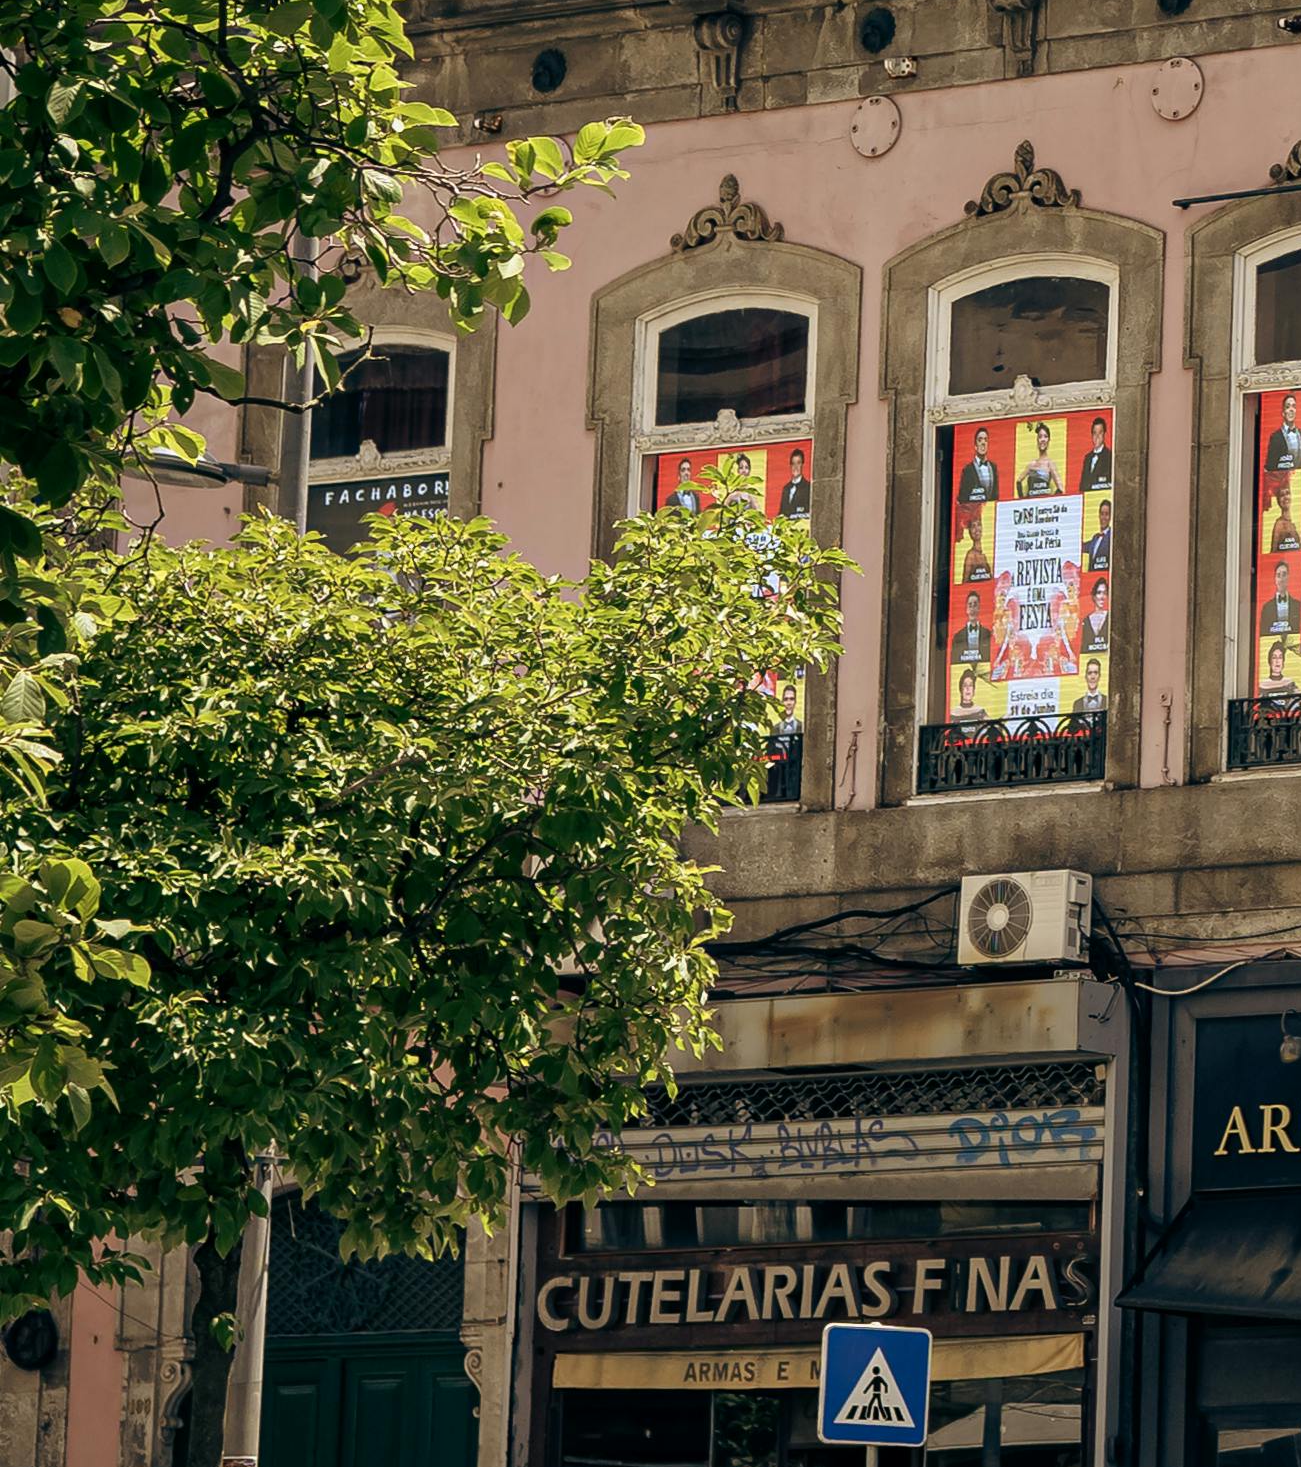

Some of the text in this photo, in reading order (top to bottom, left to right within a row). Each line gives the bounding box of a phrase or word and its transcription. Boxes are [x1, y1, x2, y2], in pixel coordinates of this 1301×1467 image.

[1017, 558, 1062, 586] REVISTA
[1019, 603, 1052, 630] FESTA
[537, 1253, 1096, 1333] CUTELARIAS FNAS
[684, 1360, 756, 1384] ARMAS
[777, 1361, 790, 1380] E
